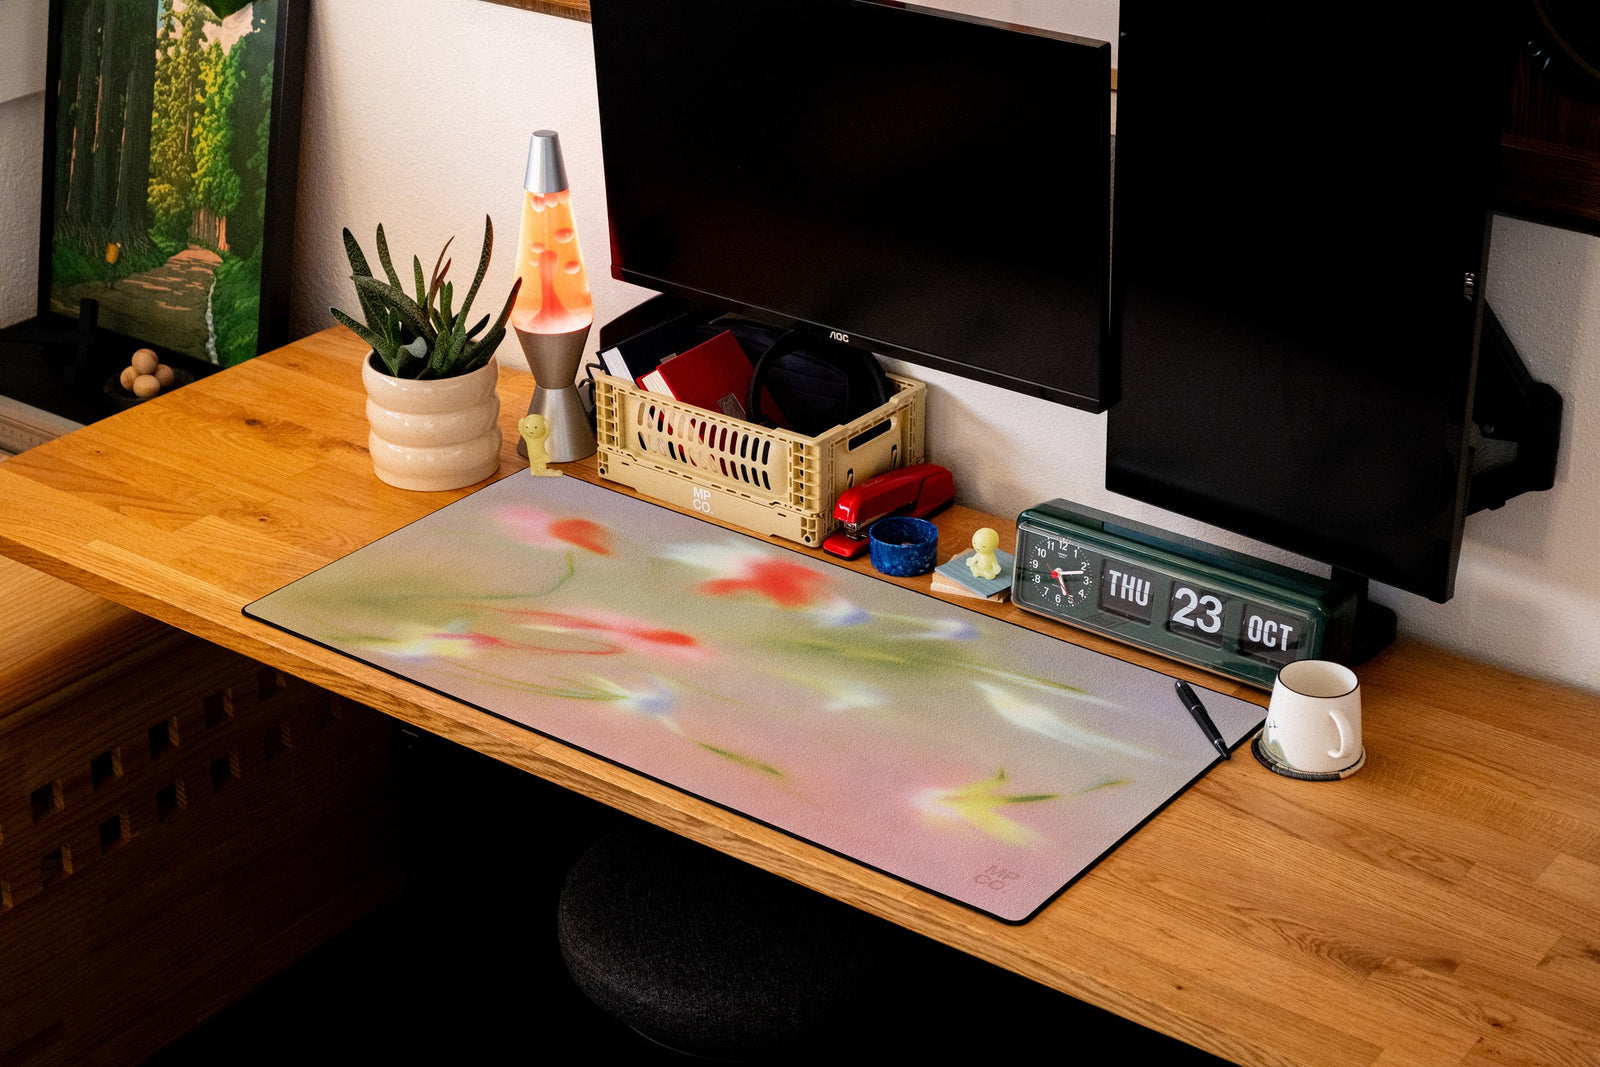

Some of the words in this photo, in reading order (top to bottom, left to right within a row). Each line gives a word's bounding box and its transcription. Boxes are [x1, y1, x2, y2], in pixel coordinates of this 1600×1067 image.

[829, 330, 849, 343] AOC
[693, 486, 711, 500] MP
[693, 498, 714, 515] CO.
[1047, 540, 1055, 551] 11
[1059, 541, 1068, 551] 12
[1037, 547, 1047, 558] 10
[1073, 549, 1078, 558] 1
[1032, 559, 1039, 569] 9
[1080, 561, 1087, 571] 2
[1034, 574, 1041, 583] 8
[1083, 576, 1089, 585] 3
[1043, 586, 1049, 595] 7
[1078, 589, 1085, 598] 4
[1055, 594, 1061, 603] 6
[1109, 569, 1151, 607] THU
[1172, 587, 1223, 634] 23
[1247, 615, 1293, 652] OCT
